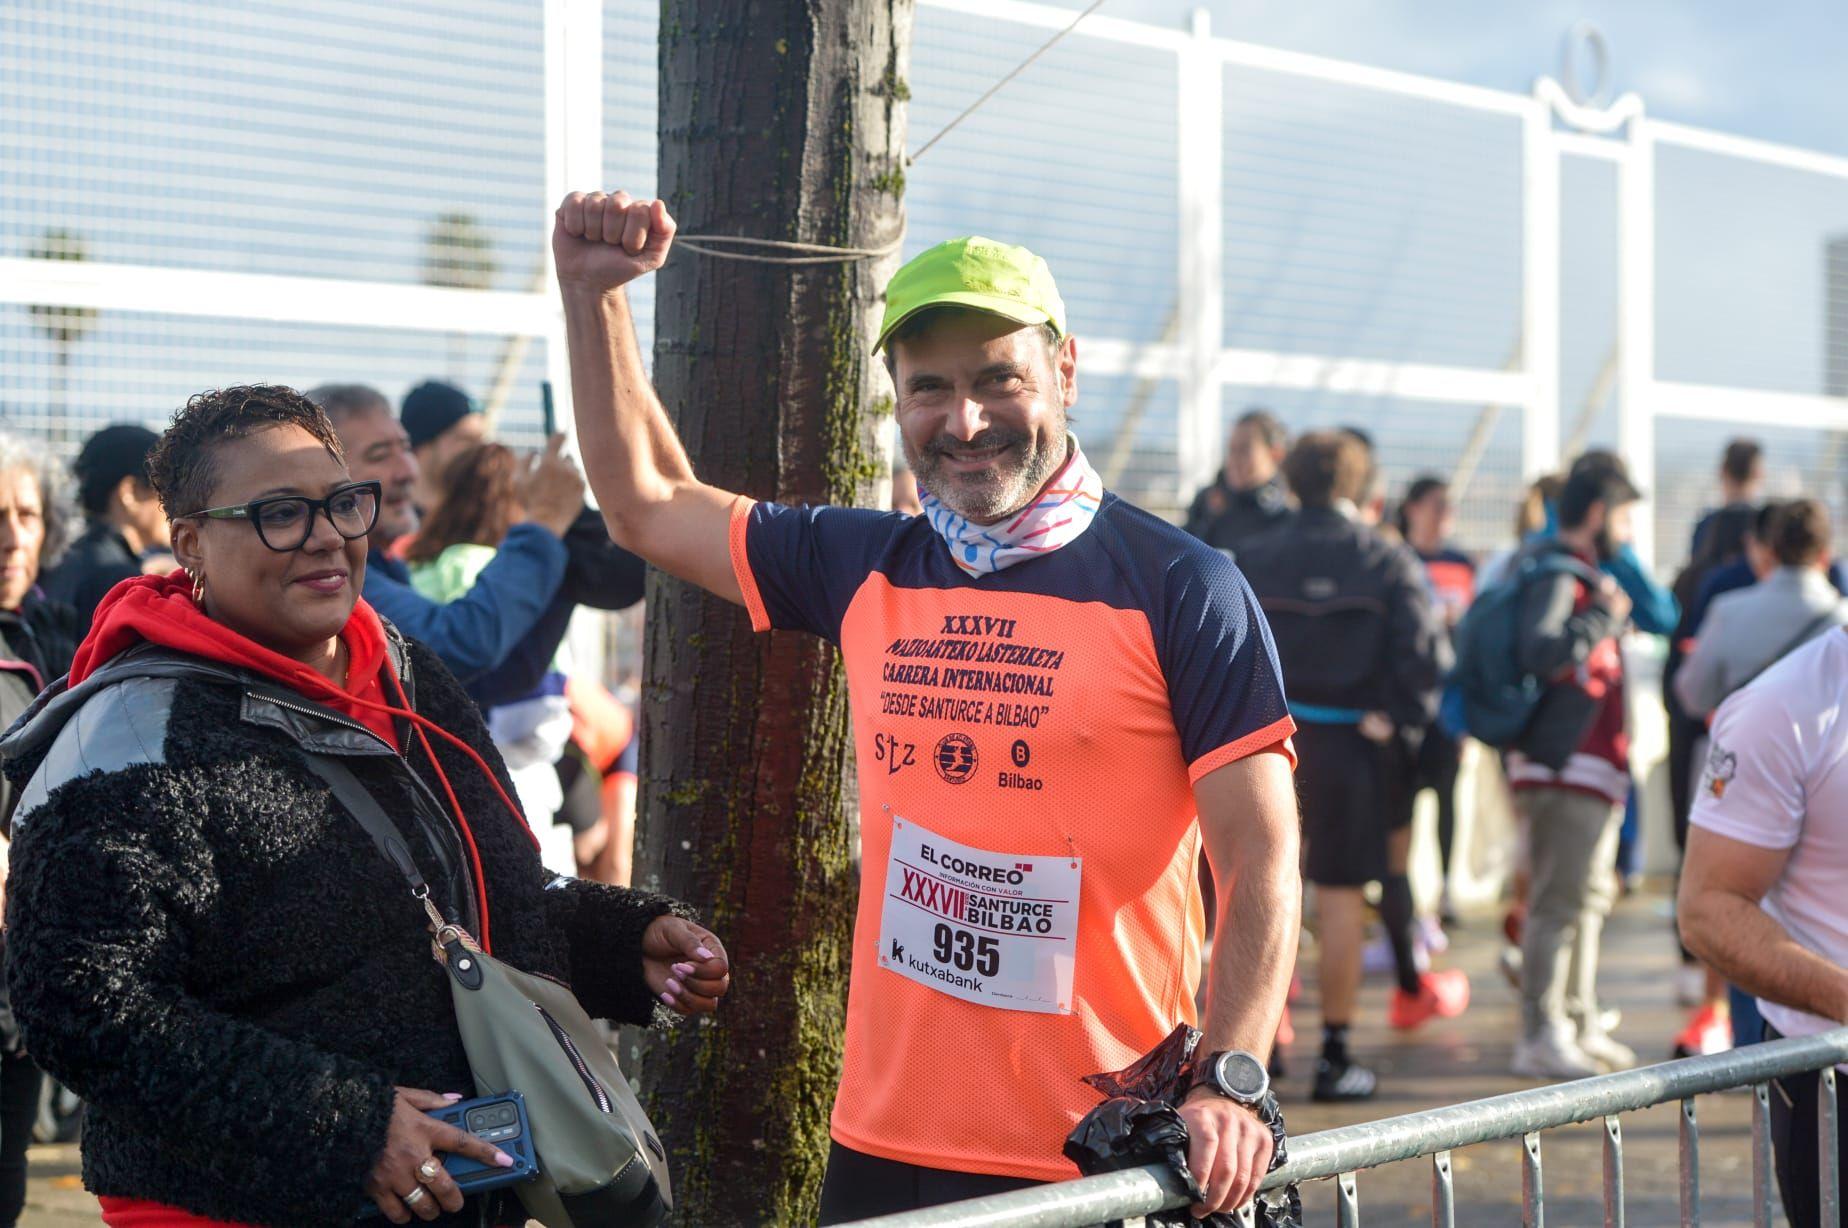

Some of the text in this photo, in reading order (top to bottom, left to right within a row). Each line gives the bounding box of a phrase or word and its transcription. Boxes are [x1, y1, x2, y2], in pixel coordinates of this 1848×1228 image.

[940, 615, 1017, 638] XXXVII
[885, 638, 1065, 670] NAZIOARTEKO LASTERKETA
[883, 662, 1054, 697] CARRERA INTERNACIONAL
[918, 695, 984, 723] SANTURCE
[984, 702, 993, 724] A
[998, 772, 1043, 790] Bilbao
[920, 843, 1024, 885] EL CORREO
[939, 871, 1023, 896] INFORMACIÓN CON VALOR
[968, 894, 1053, 918] SANTURCE
[967, 908, 1052, 934] BILBAO
[932, 922, 1000, 978] 935
[909, 954, 983, 992] kutxabank
